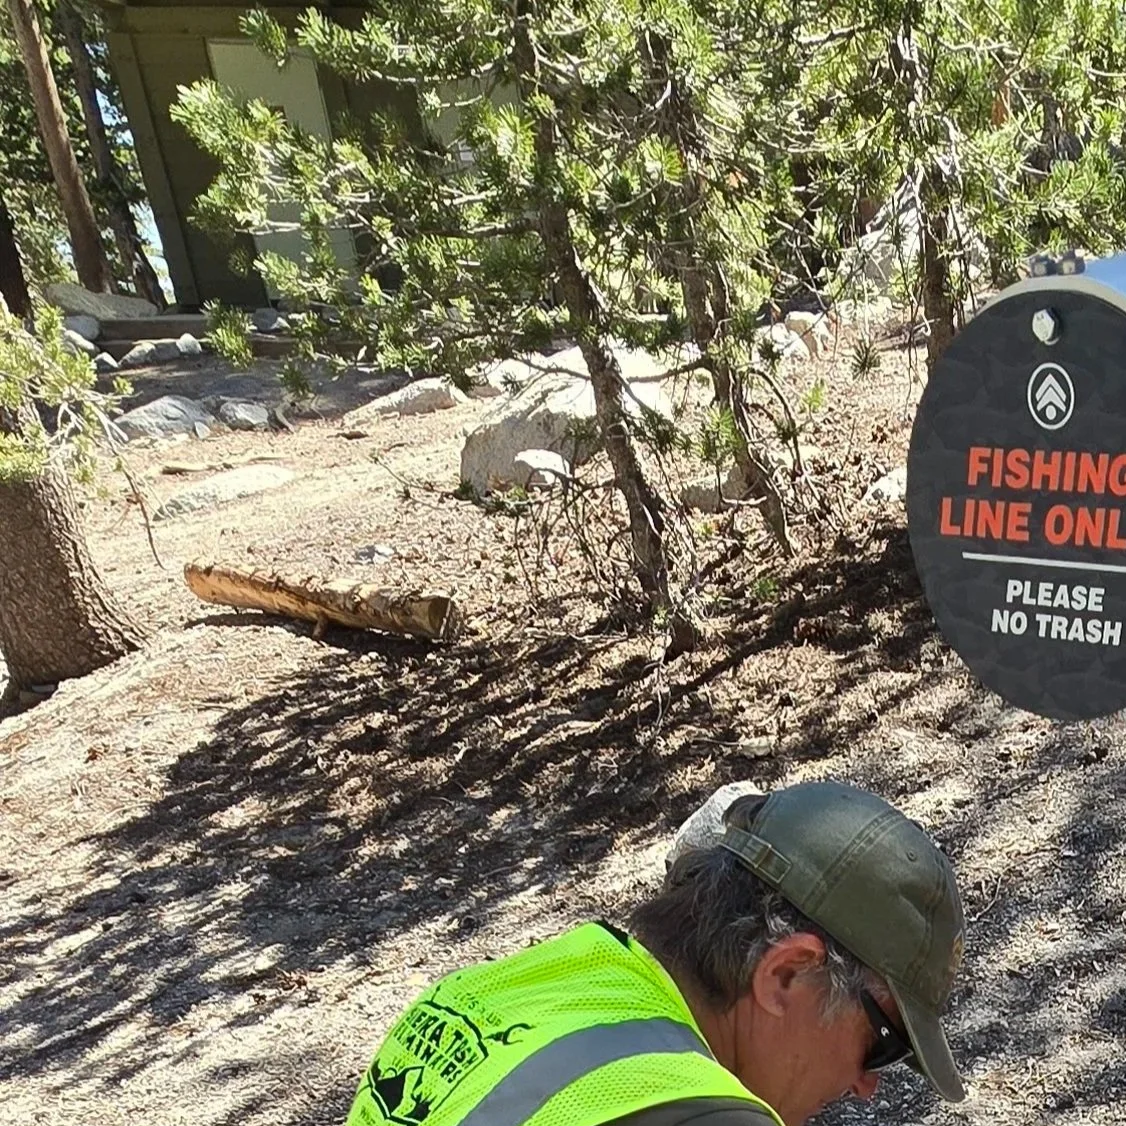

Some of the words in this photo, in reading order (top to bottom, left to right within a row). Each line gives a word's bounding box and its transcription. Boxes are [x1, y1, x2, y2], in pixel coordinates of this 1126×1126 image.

[940, 497, 1032, 542] LINE
[1006, 579, 1105, 612] PLEASE
[991, 609, 1027, 634] NO
[1036, 614, 1122, 646] TRASH
